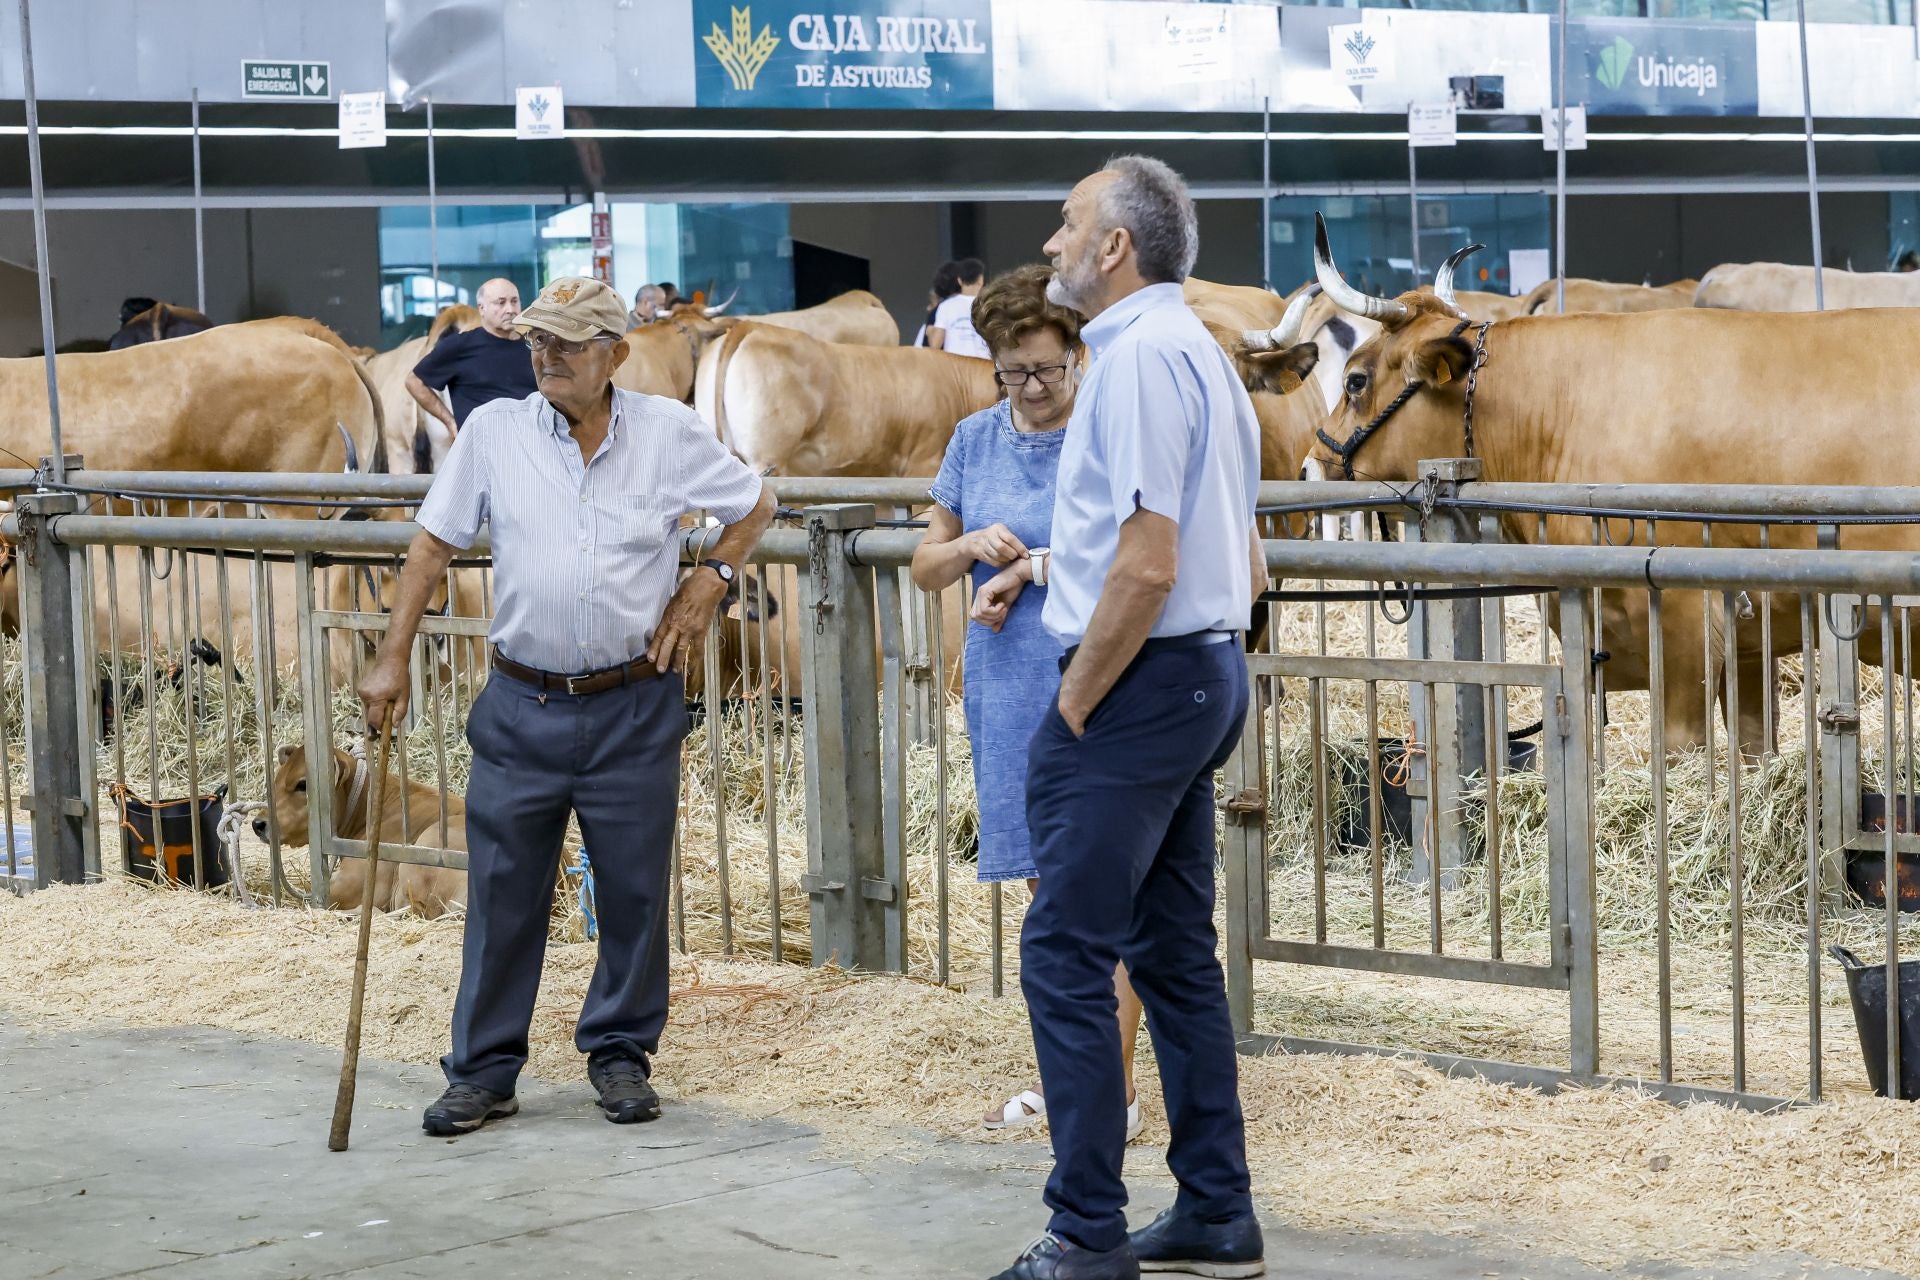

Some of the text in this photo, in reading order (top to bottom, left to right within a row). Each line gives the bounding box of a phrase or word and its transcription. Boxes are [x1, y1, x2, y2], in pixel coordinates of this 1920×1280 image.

[788, 14, 986, 54] CAJA RURAL
[252, 66, 292, 79] SALIDA DE
[795, 64, 932, 88] DE ASTURIAS
[1637, 56, 1717, 96] Unicaja
[247, 79, 298, 92] EMERGENCIA
